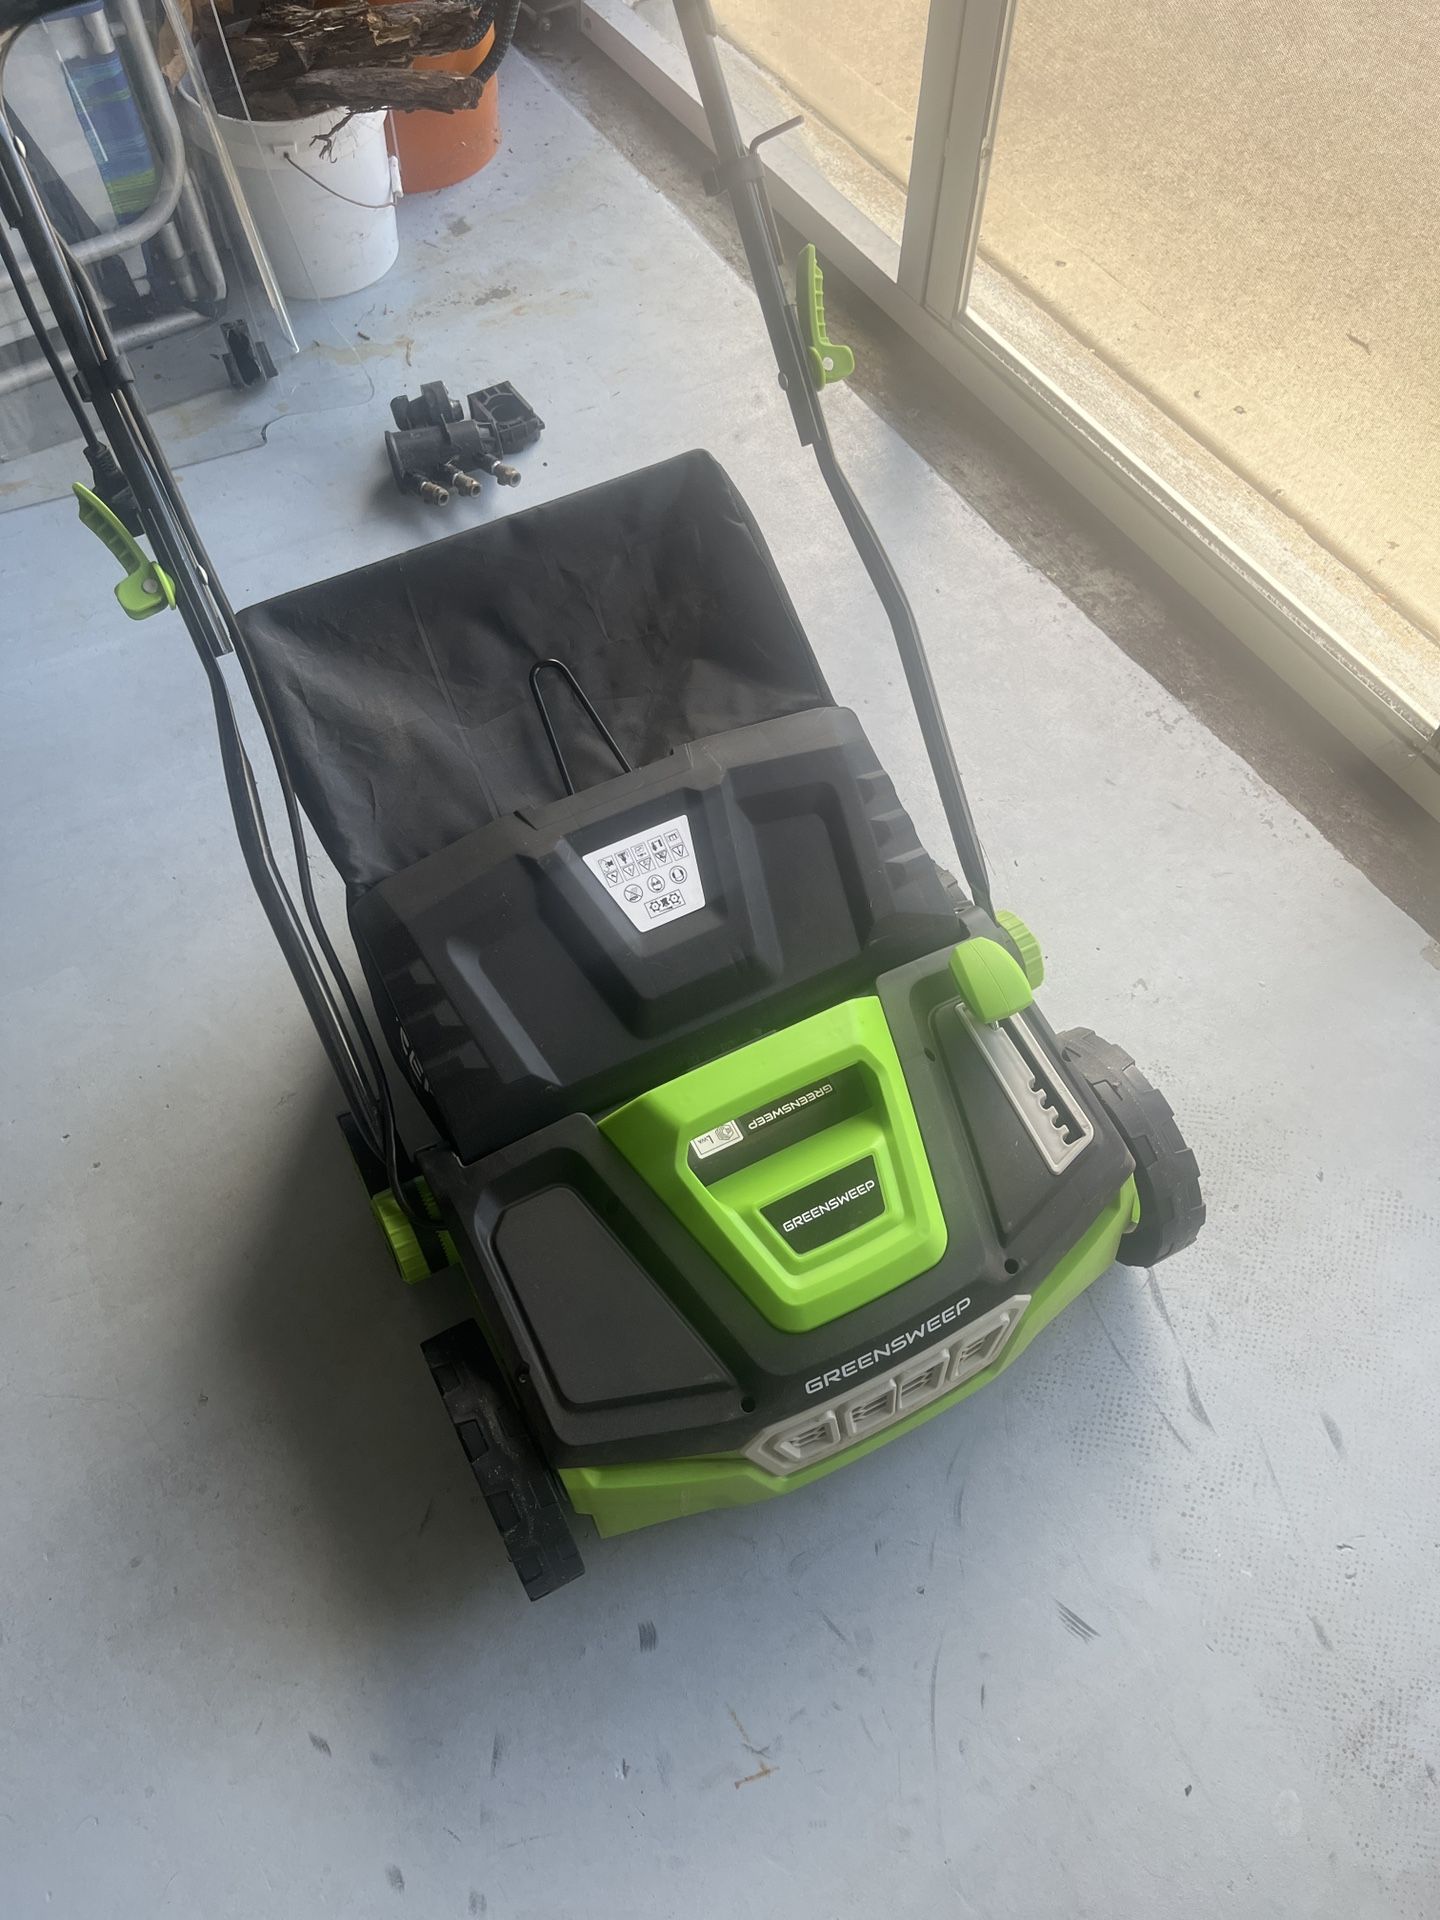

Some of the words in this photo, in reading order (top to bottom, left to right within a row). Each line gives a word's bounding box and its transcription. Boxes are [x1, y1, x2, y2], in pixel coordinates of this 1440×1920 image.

[748, 1083, 833, 1131] GREENSWEEP
[782, 1179, 876, 1233] GREENSWEEP
[805, 1296, 972, 1395] GREENSWEEP
